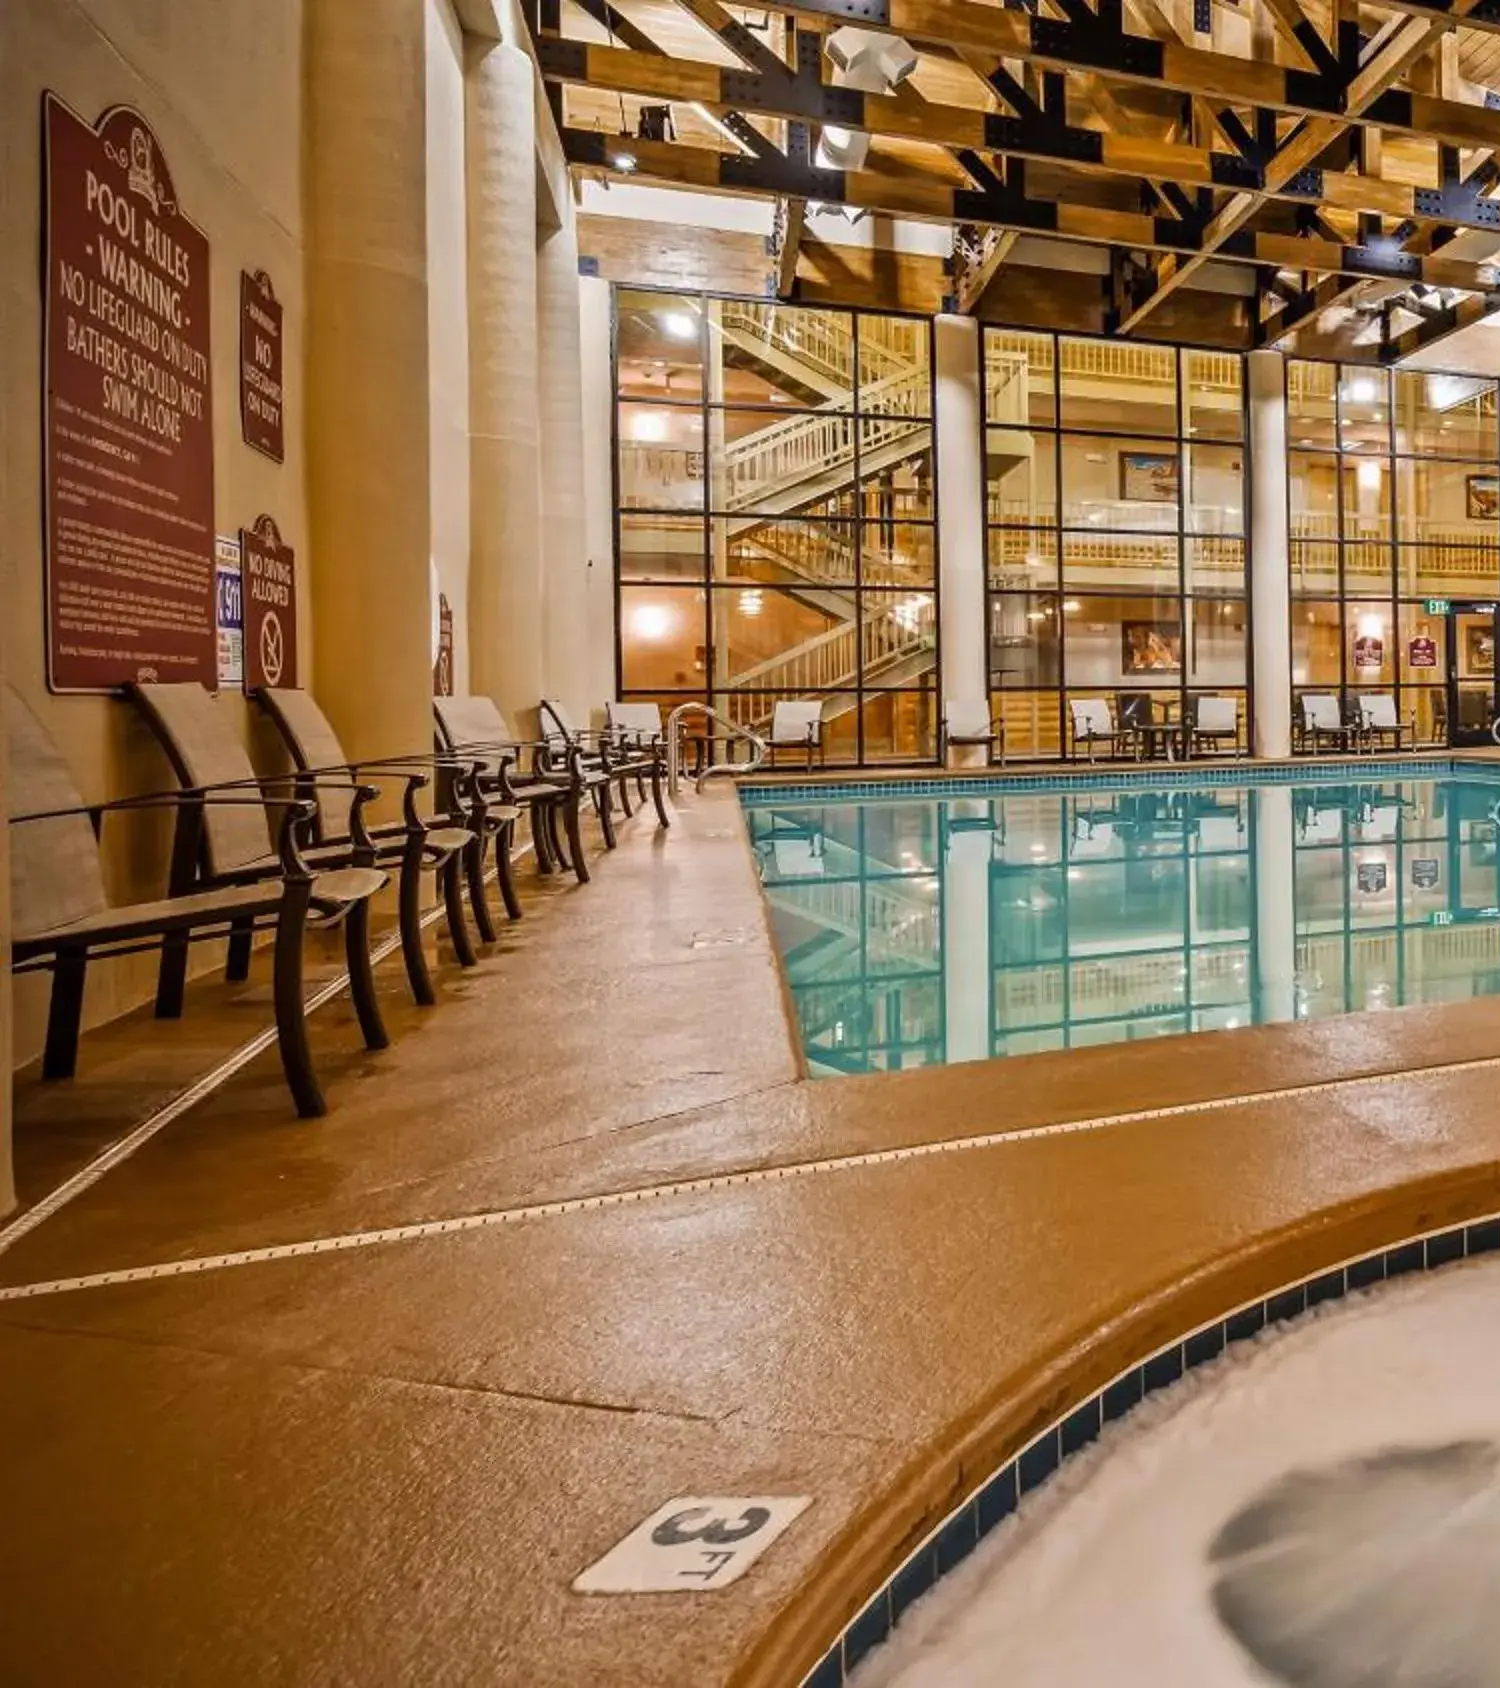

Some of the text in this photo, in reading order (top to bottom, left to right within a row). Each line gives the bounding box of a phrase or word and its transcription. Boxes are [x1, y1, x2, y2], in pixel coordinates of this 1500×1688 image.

[86, 169, 190, 288] POOL RULES
[98, 233, 182, 329] WARNING
[60, 258, 208, 385] NO LIFEGUARD ON DUTY
[67, 315, 203, 421] BATHERS SHOULD NOT
[255, 334, 273, 369] NO
[103, 375, 139, 422] SWIM
[141, 399, 182, 443] ALONE
[249, 551, 263, 575] NO
[263, 557, 292, 585] DIVING
[252, 577, 289, 607] ALLOWED
[1429, 600, 1447, 615] EXIT
[651, 1507, 771, 1546] 3
[678, 1550, 737, 1580] FT
